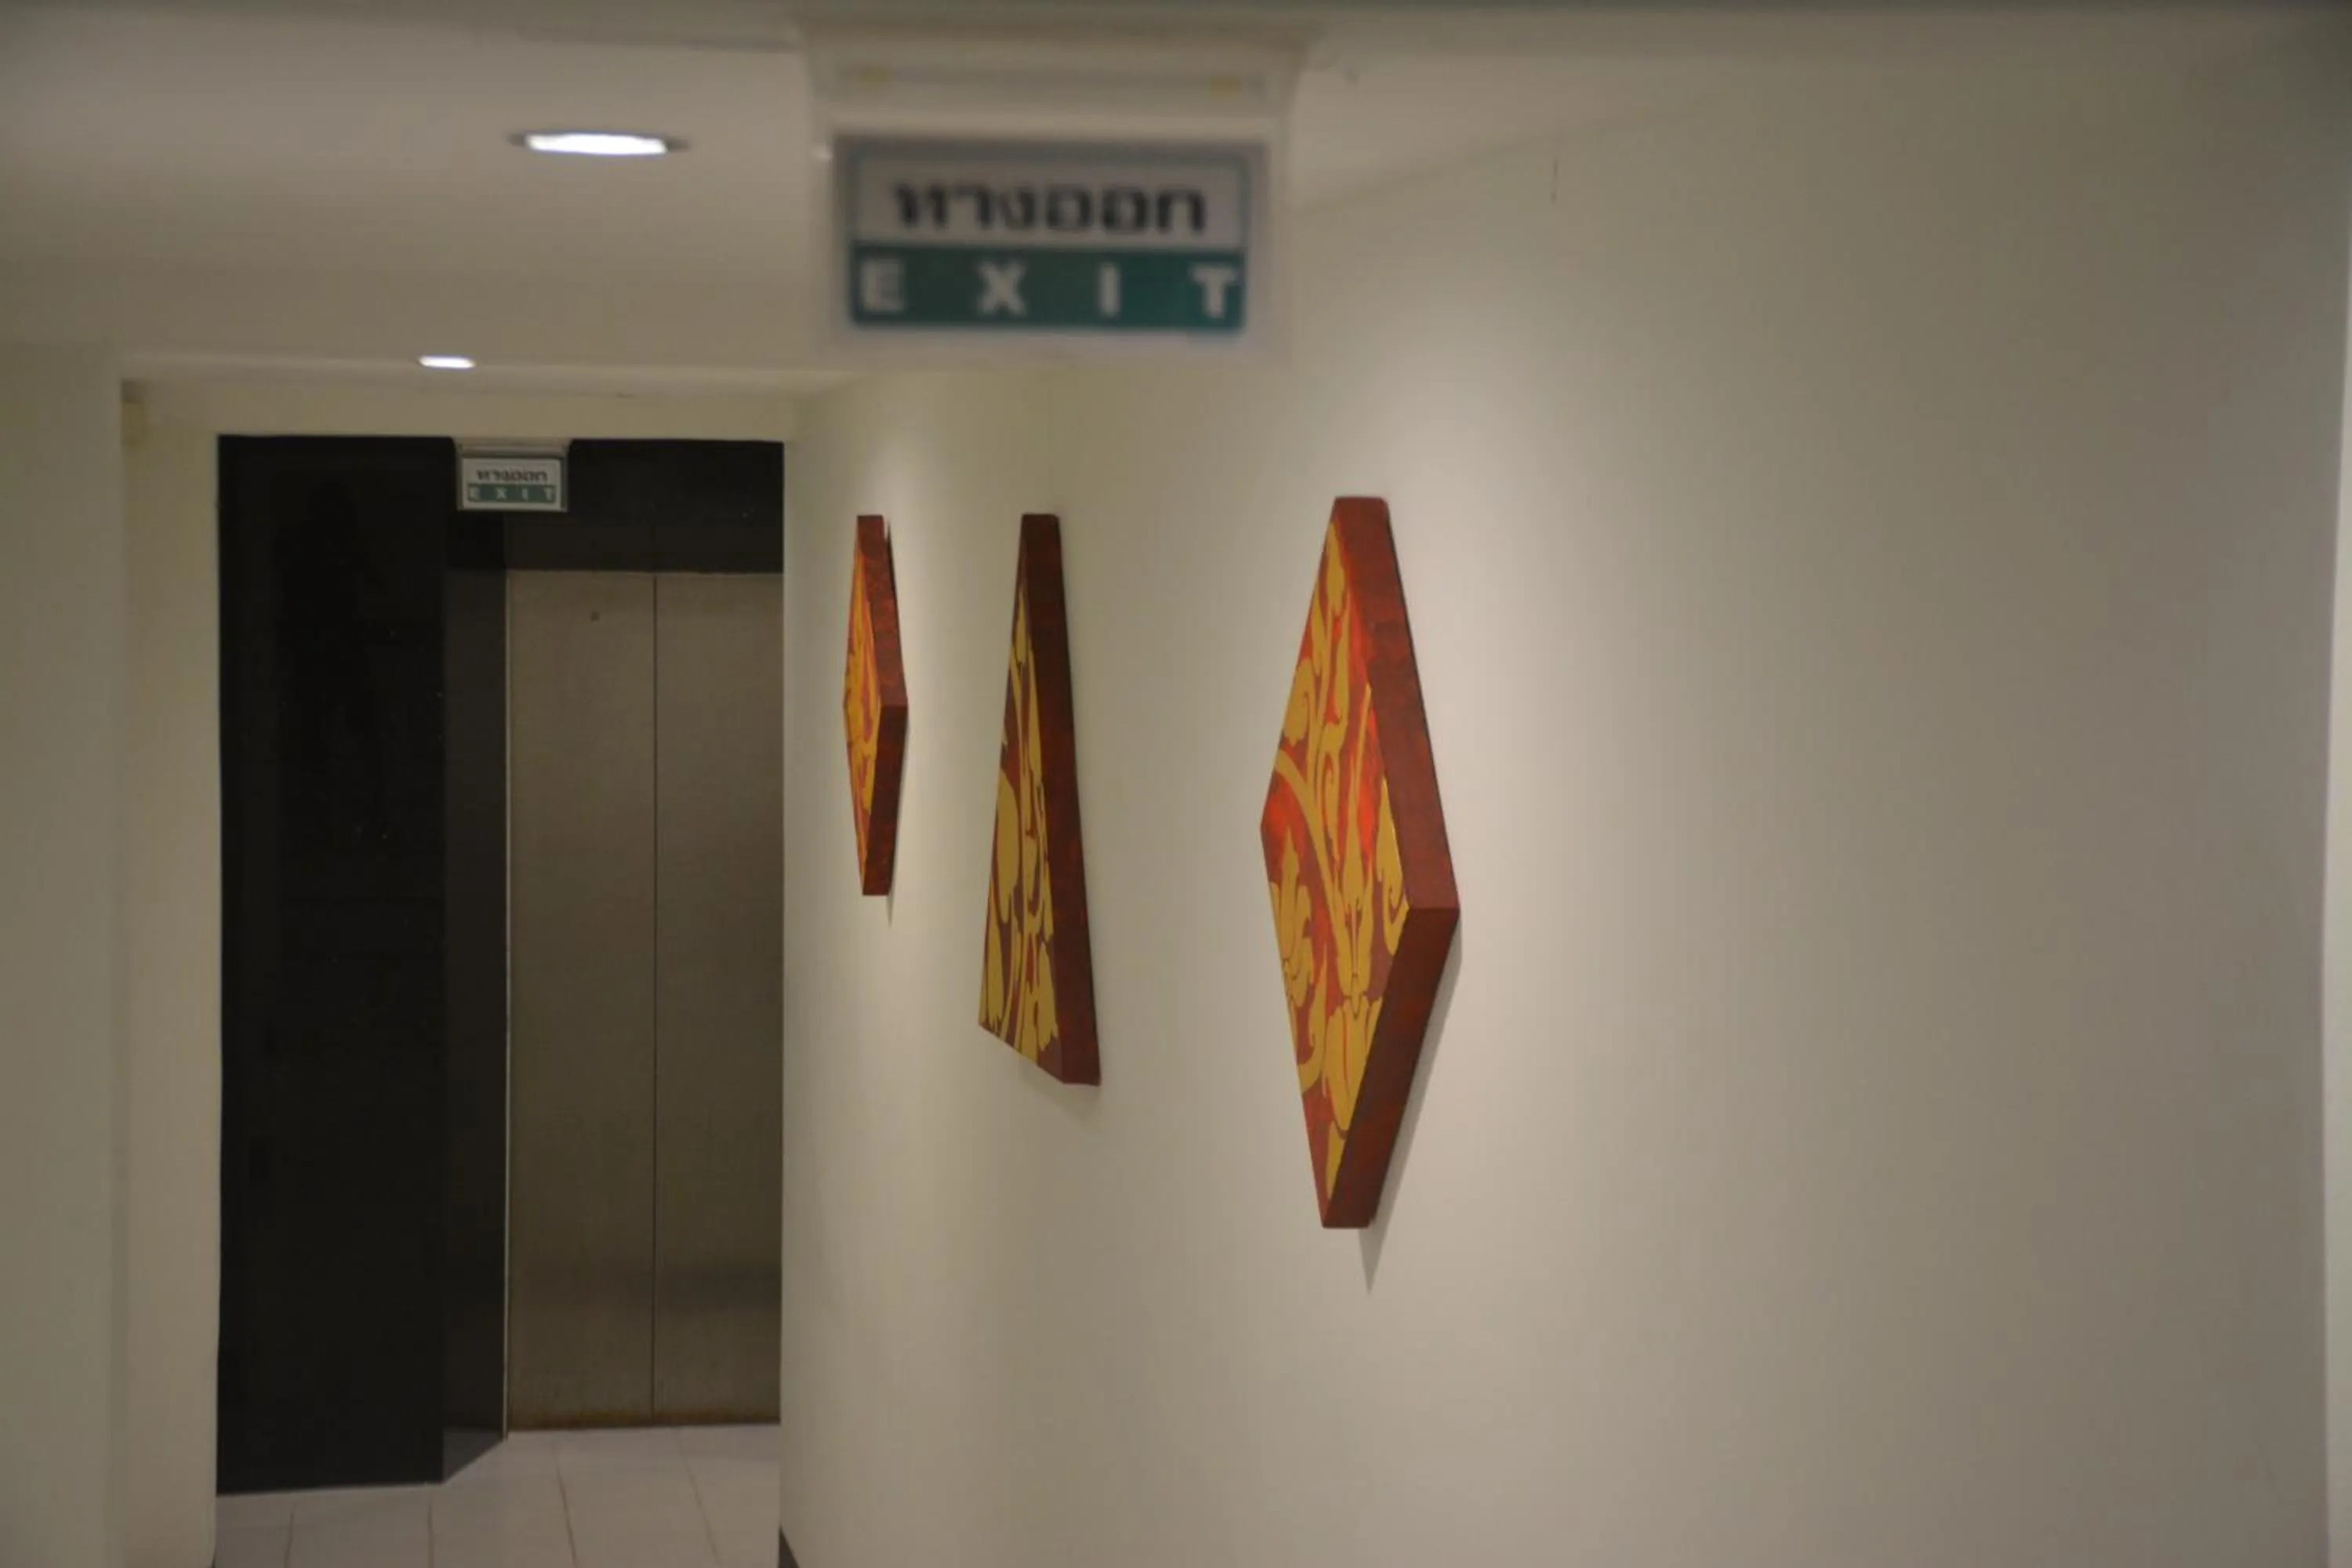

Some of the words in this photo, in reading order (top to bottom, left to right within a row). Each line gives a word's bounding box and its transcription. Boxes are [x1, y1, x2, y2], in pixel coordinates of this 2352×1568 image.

[893, 182, 1205, 232] ทางออก
[864, 258, 1236, 316] EXIT
[471, 487, 553, 501] EXIT
